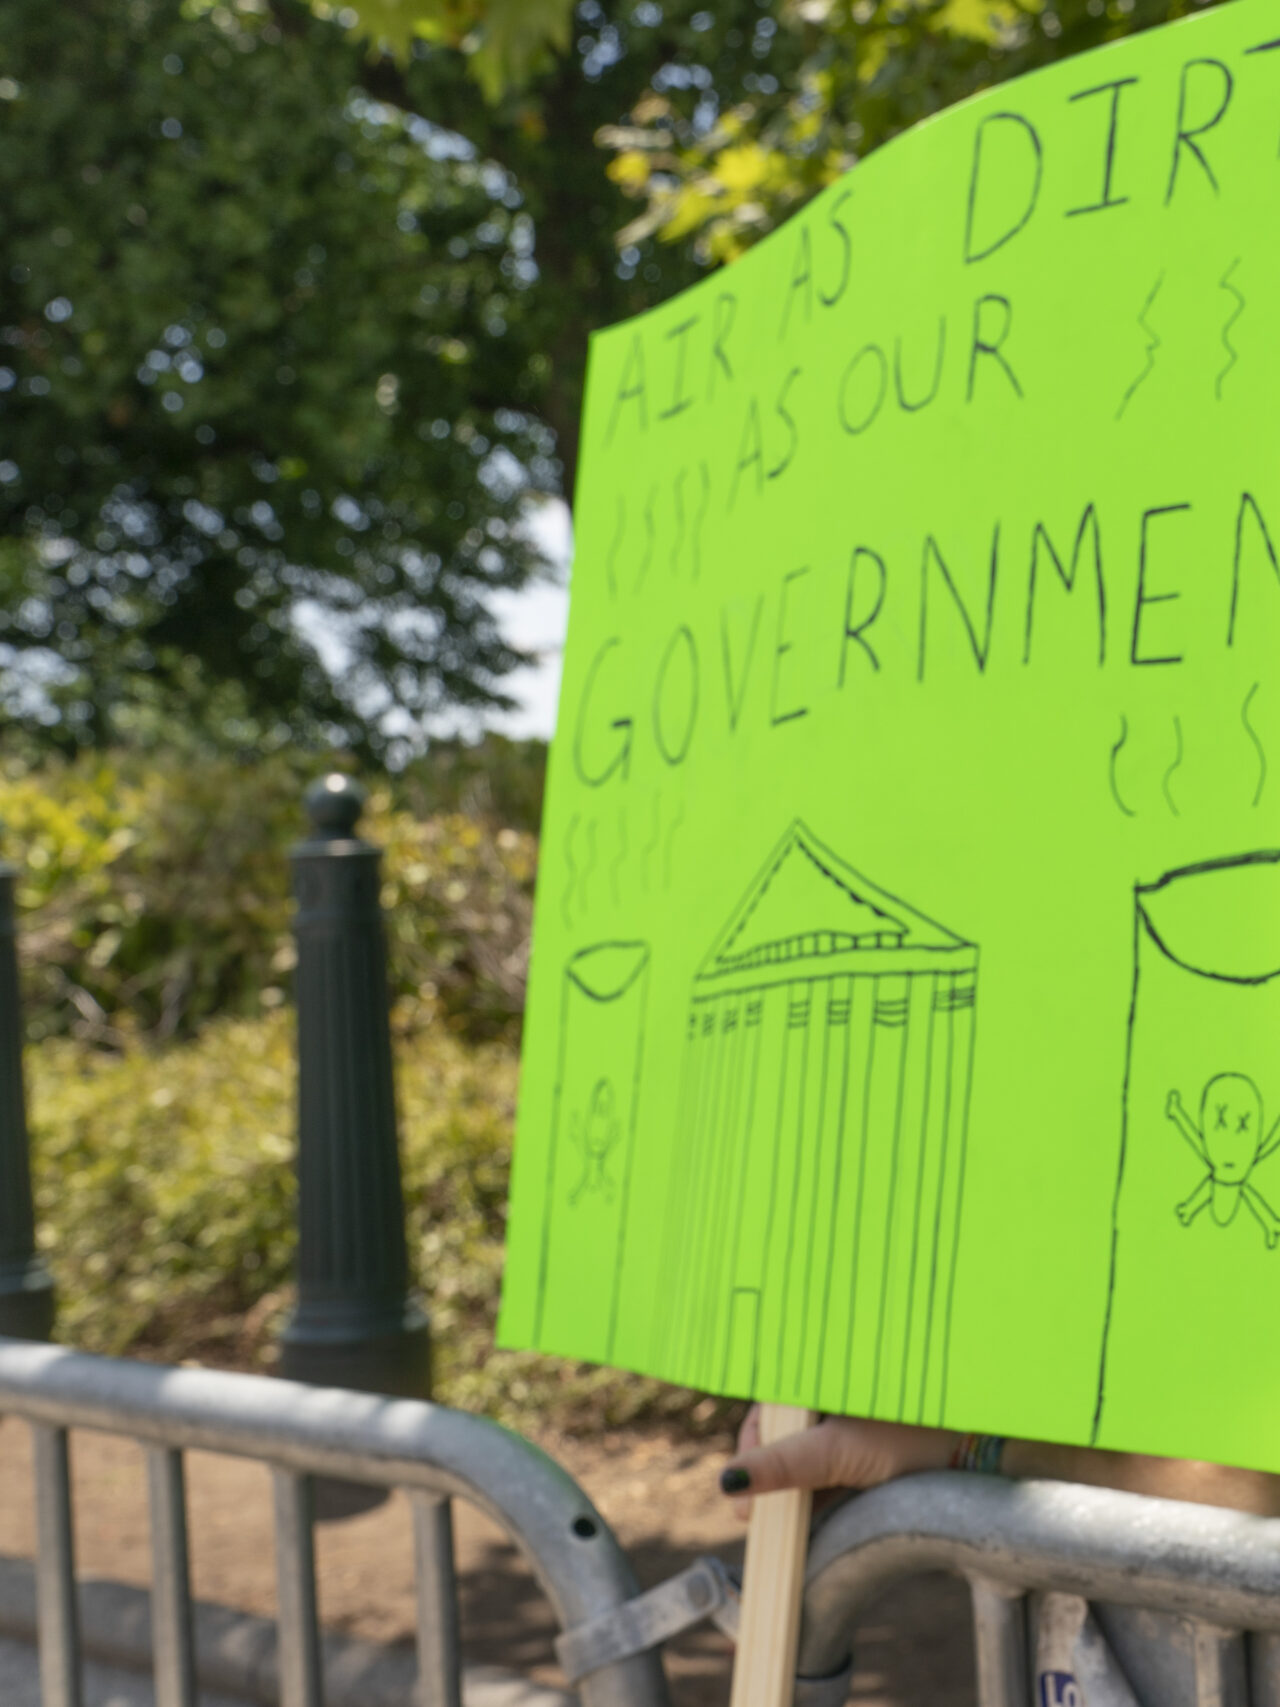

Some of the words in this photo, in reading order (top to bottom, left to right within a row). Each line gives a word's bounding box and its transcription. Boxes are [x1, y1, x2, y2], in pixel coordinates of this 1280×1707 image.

[604, 292, 738, 451] AIR
[777, 187, 853, 341] AS
[726, 366, 802, 516] AS
[837, 293, 1025, 437] OUR
